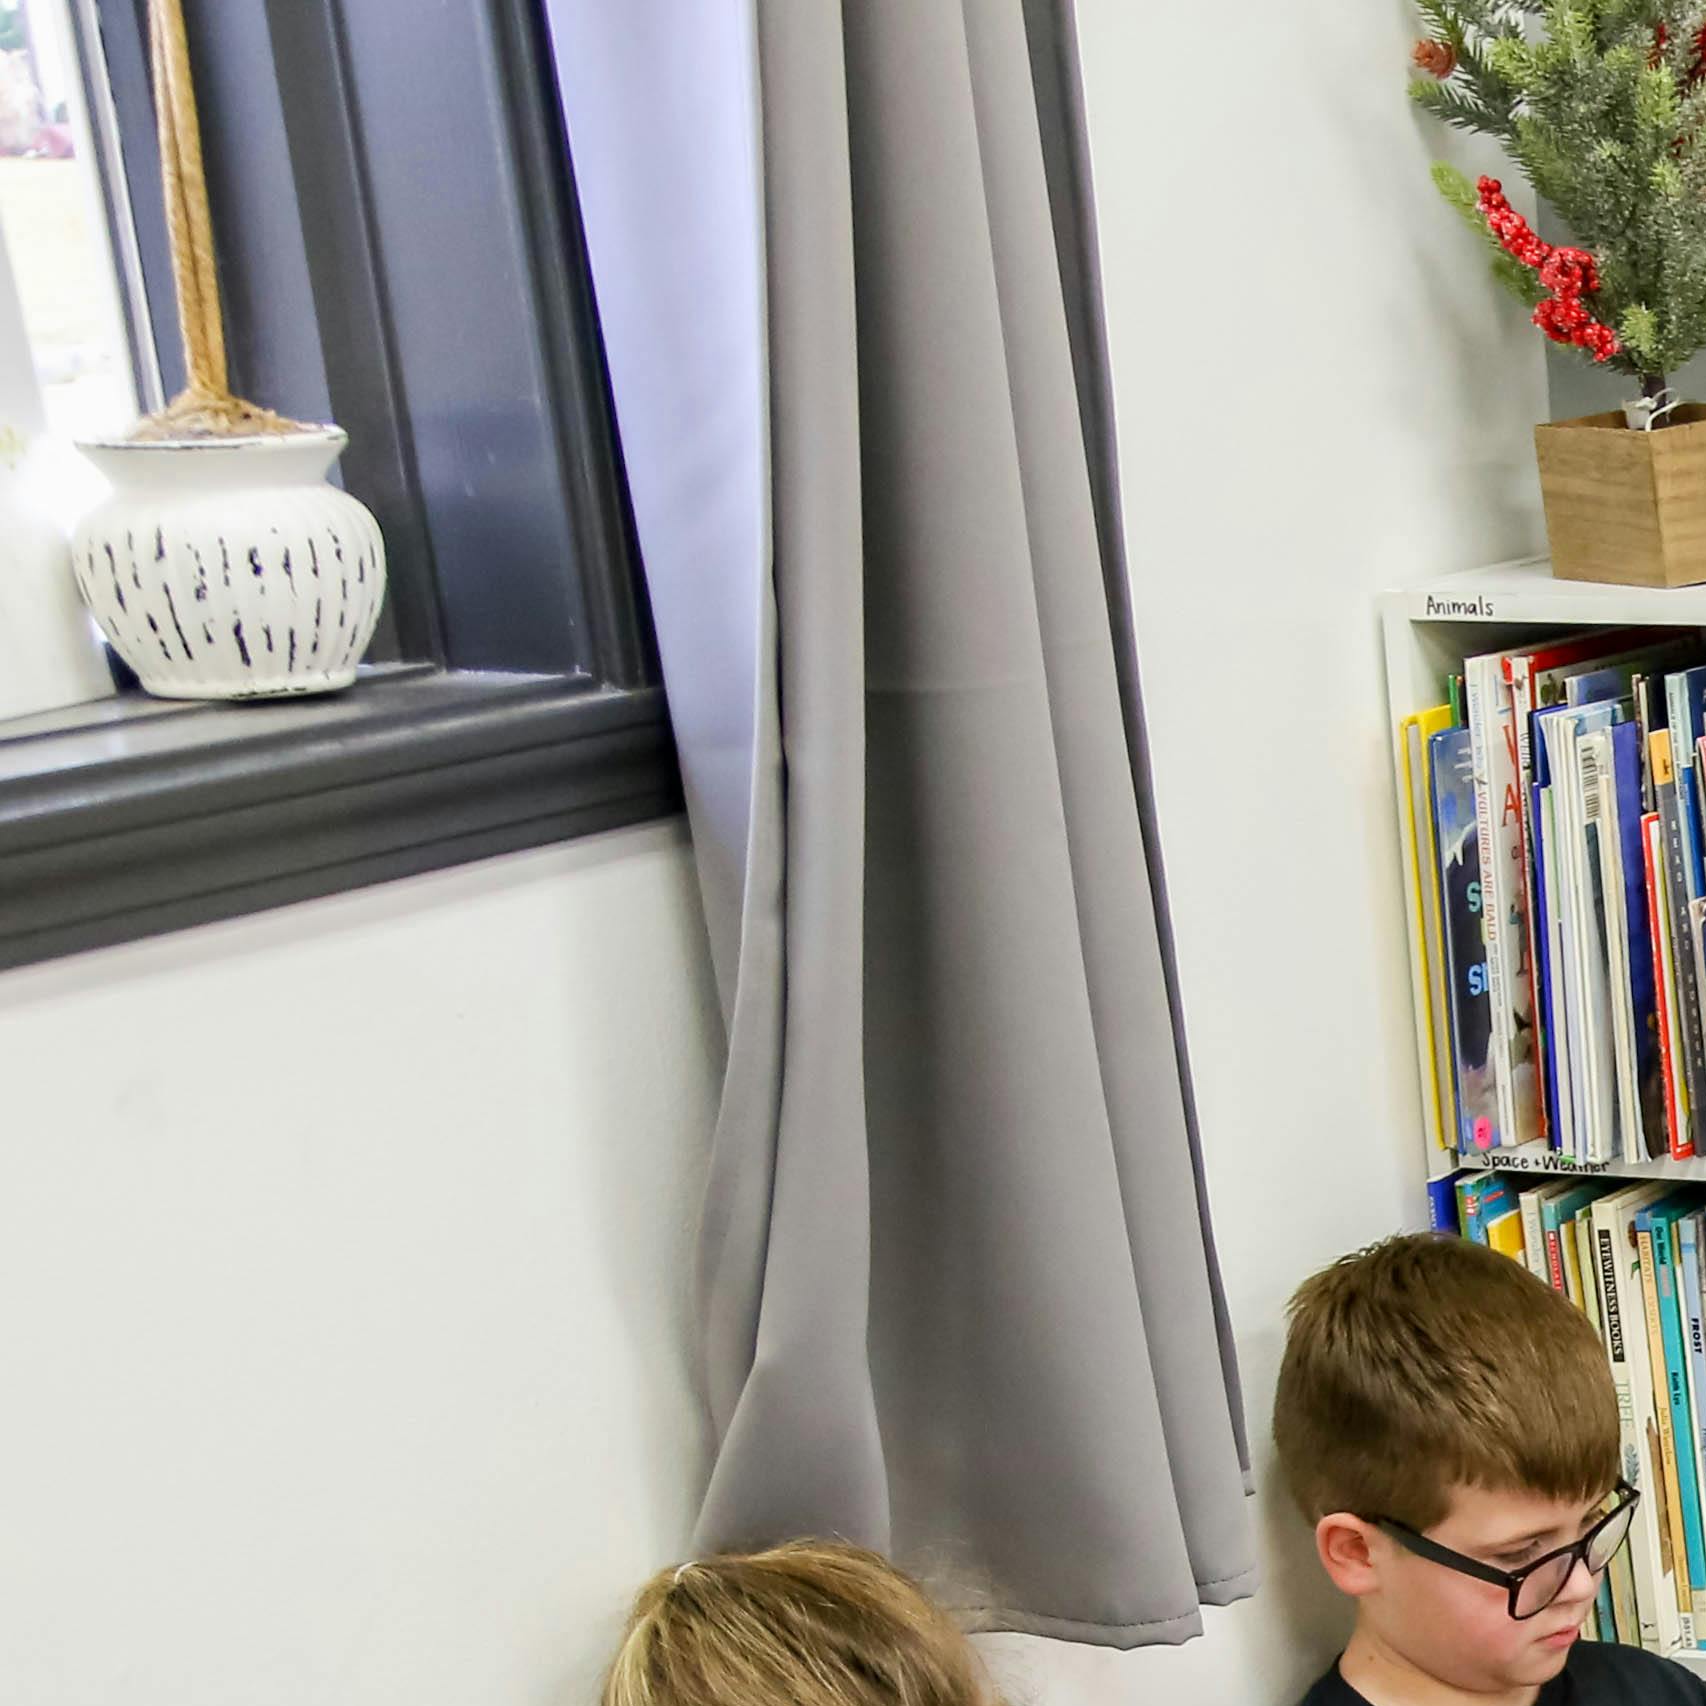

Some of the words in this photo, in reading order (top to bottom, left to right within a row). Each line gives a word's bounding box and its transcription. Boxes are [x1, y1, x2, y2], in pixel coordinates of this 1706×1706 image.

[1426, 595, 1493, 617] Animals
[1477, 791, 1493, 866] VULTURES
[1483, 902, 1497, 941] BALD
[1480, 1150, 1529, 1171] Space
[1599, 1234, 1618, 1308] EYEWITNESS
[1607, 1312, 1623, 1359] BOOKS
